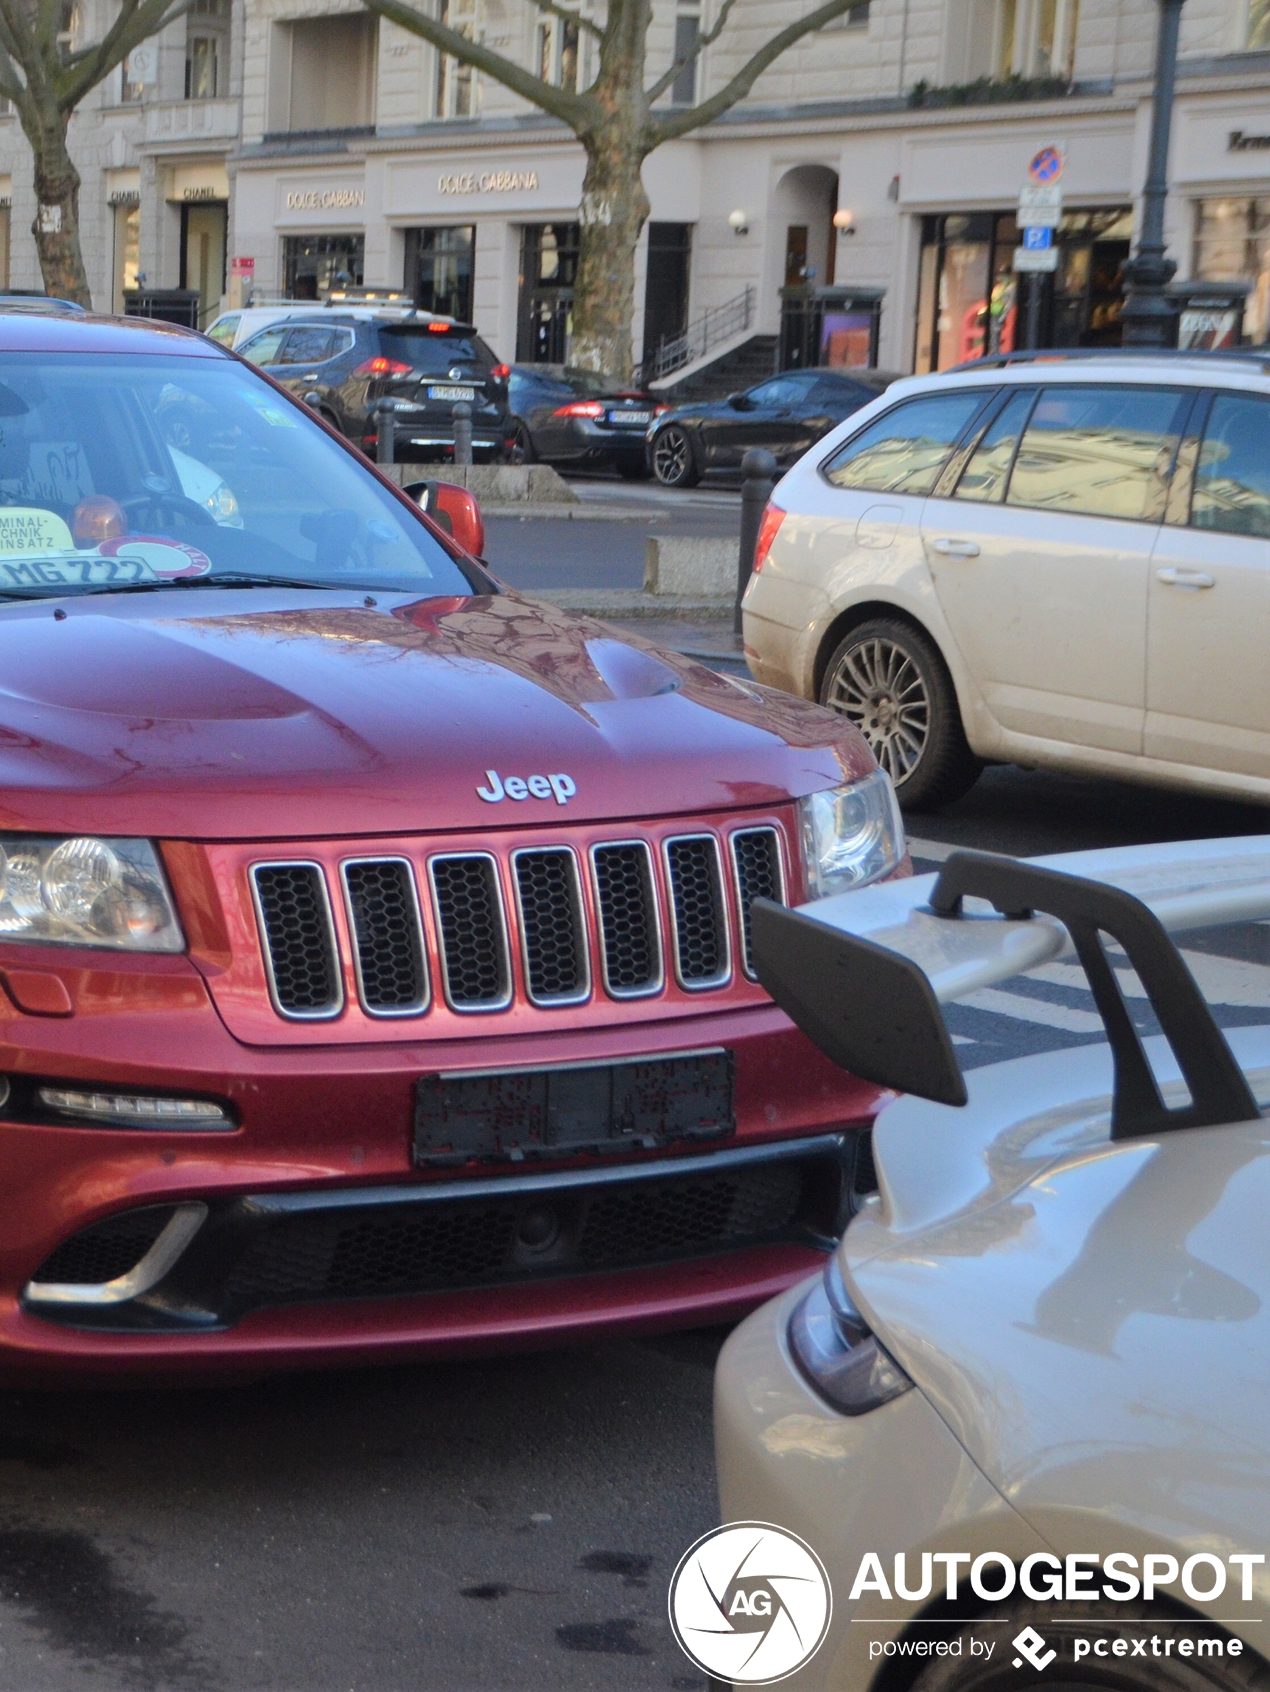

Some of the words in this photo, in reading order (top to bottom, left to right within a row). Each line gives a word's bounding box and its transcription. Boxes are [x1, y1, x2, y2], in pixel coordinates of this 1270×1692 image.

[183, 187, 216, 200] CHANEL
[438, 175, 474, 194] DOLCE
[480, 171, 538, 192] GABBANA
[287, 191, 318, 210] DOLCE
[174, 543, 209, 571] HALT
[3, 562, 67, 584] MG
[67, 560, 152, 582] 722
[476, 769, 577, 805] Jeep
